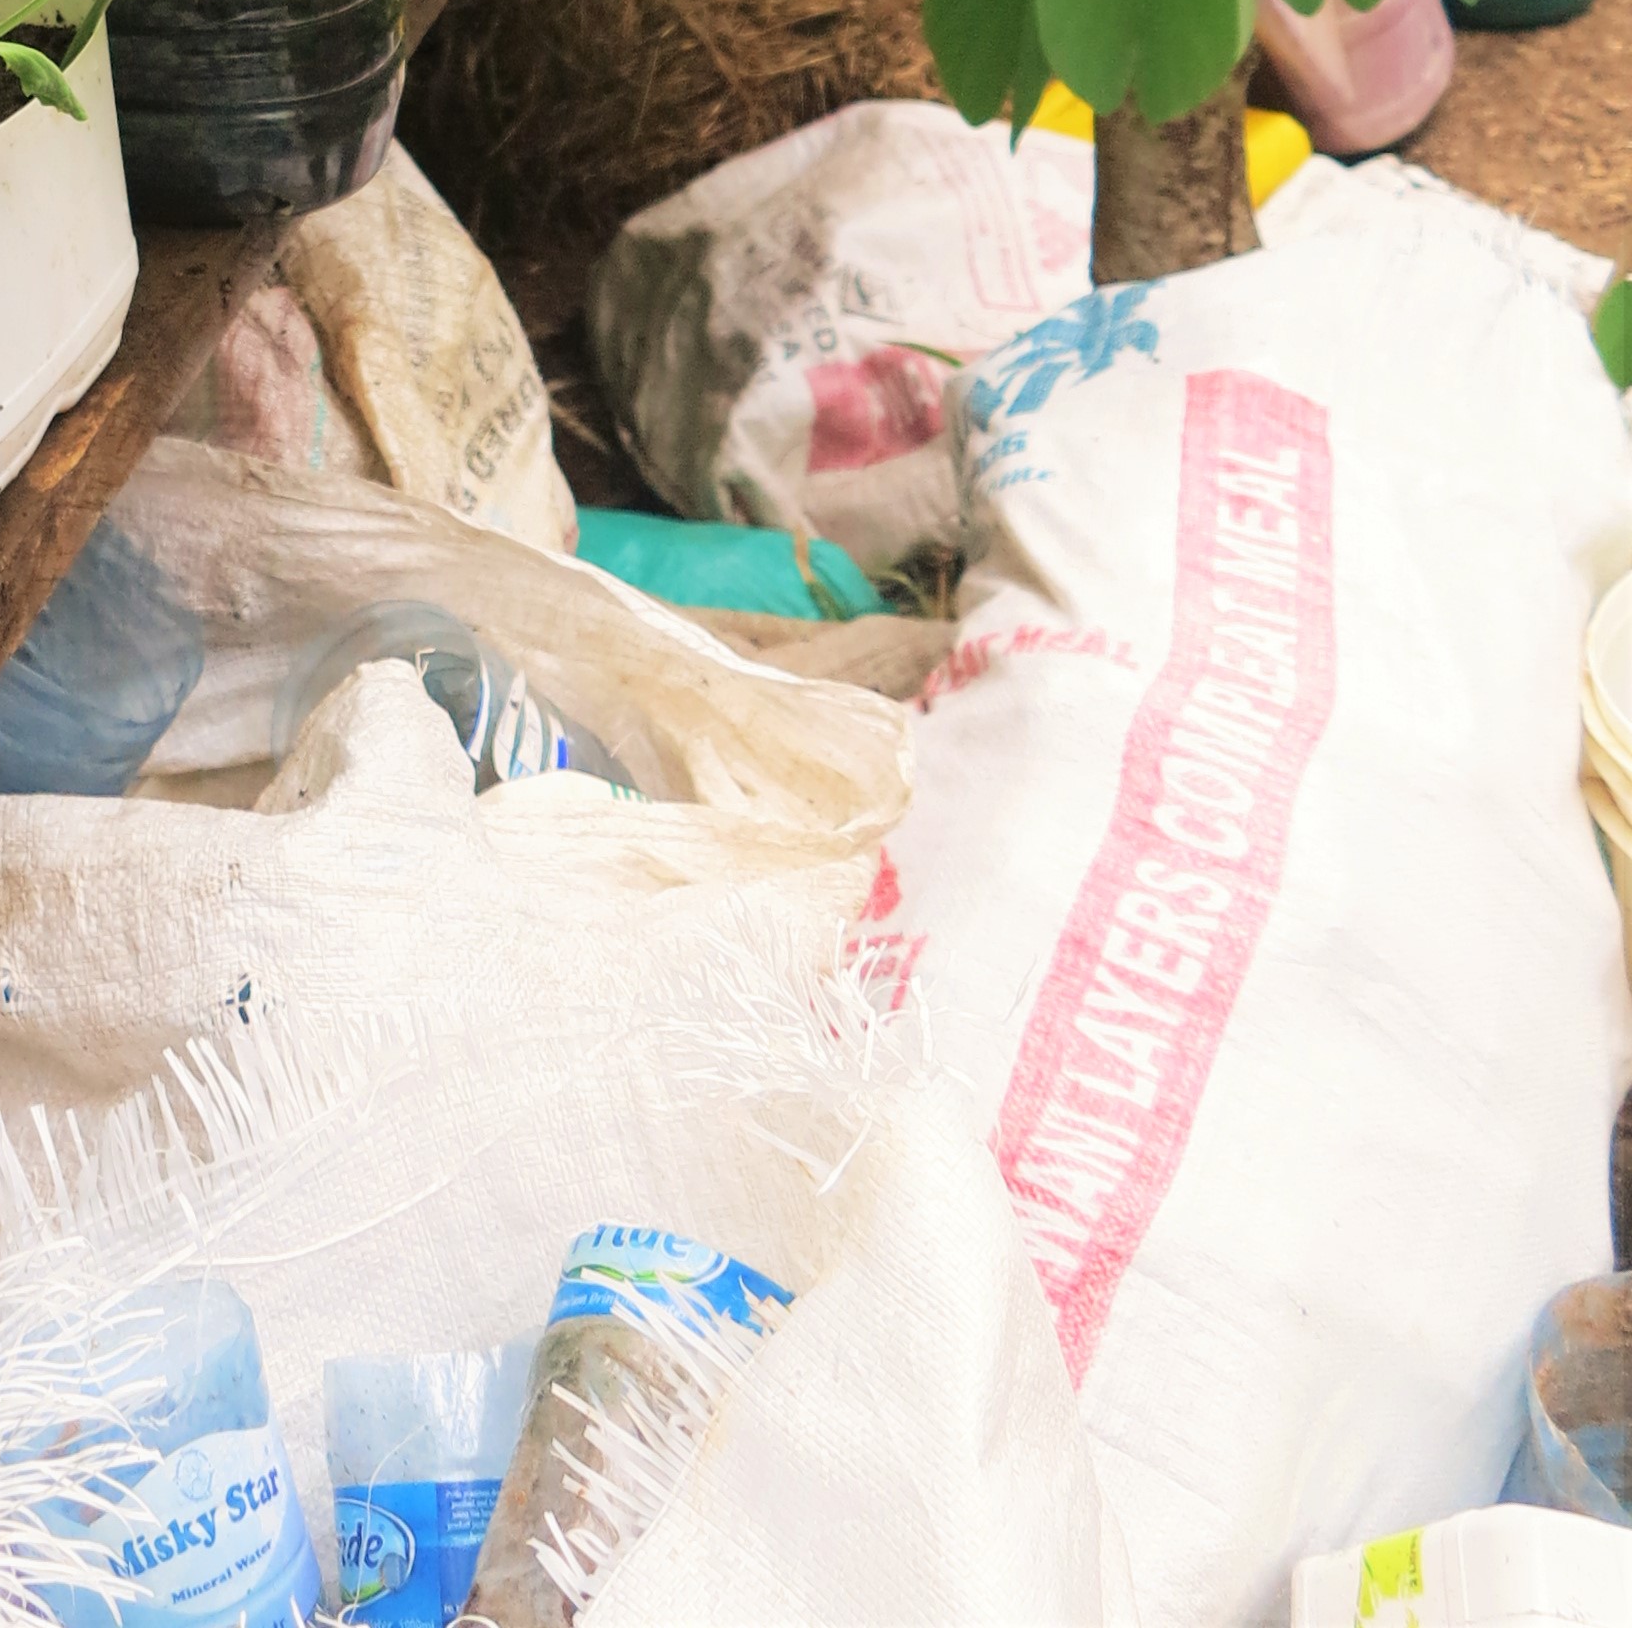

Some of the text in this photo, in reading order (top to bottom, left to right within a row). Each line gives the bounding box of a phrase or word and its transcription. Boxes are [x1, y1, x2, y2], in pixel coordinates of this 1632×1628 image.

[1212, 447, 1300, 592] MEAL
[1153, 586, 1299, 860] COMPLEAT
[1061, 859, 1232, 1110] LAYERS
[107, 1466, 279, 1579] Misky Star
[171, 1537, 273, 1605] Mineral Water
[338, 1521, 384, 1569] ide
